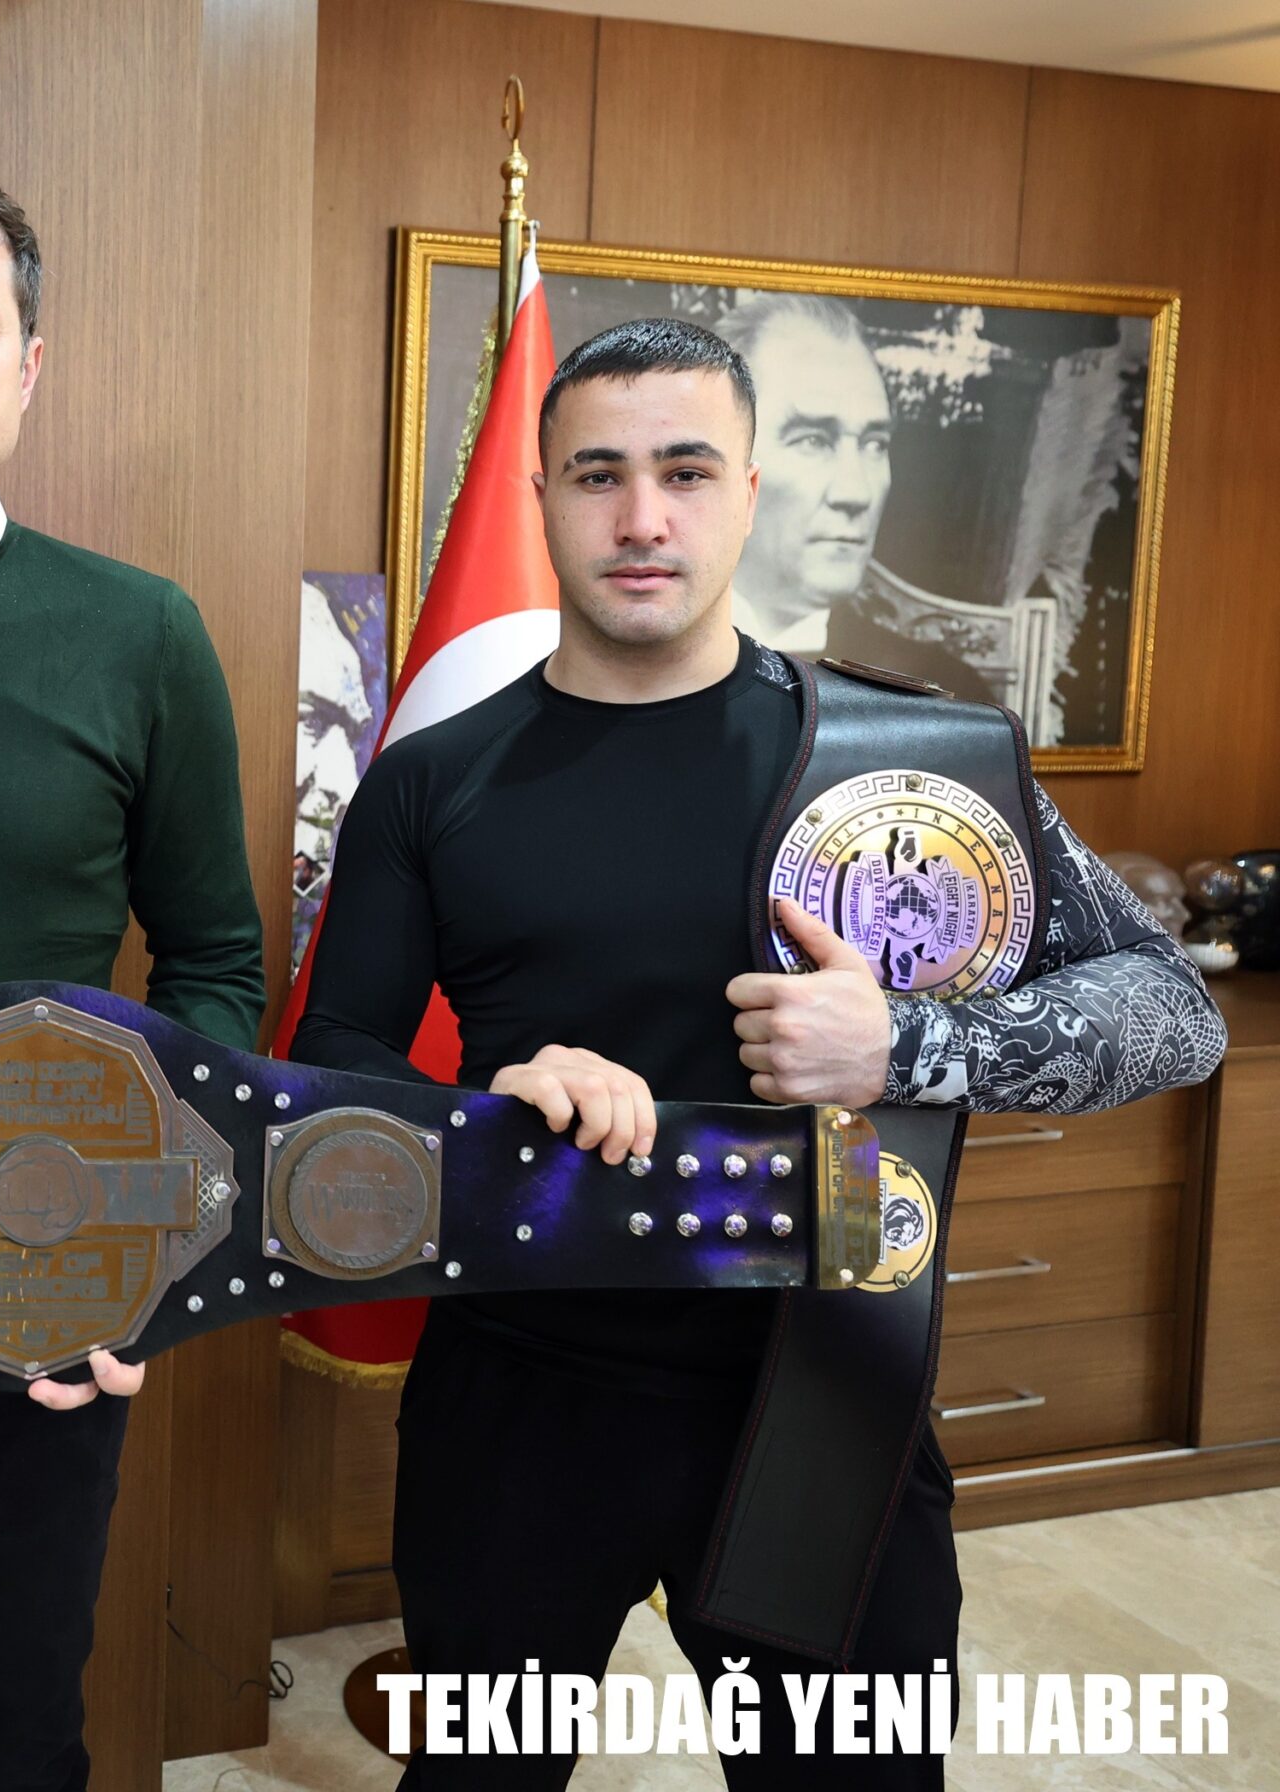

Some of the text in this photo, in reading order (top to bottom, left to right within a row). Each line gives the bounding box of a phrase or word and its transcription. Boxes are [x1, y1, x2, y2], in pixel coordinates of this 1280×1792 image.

[849, 870, 865, 940] CHAMPIONSHIPS
[868, 860, 885, 952] DOVUS GECESI
[942, 876, 959, 945] FIGHT NIGHT
[964, 884, 977, 940] KARATAY
[831, 1129, 843, 1170] NIGHT
[832, 1174, 844, 1193] OF
[63, 1252, 103, 1274] OF
